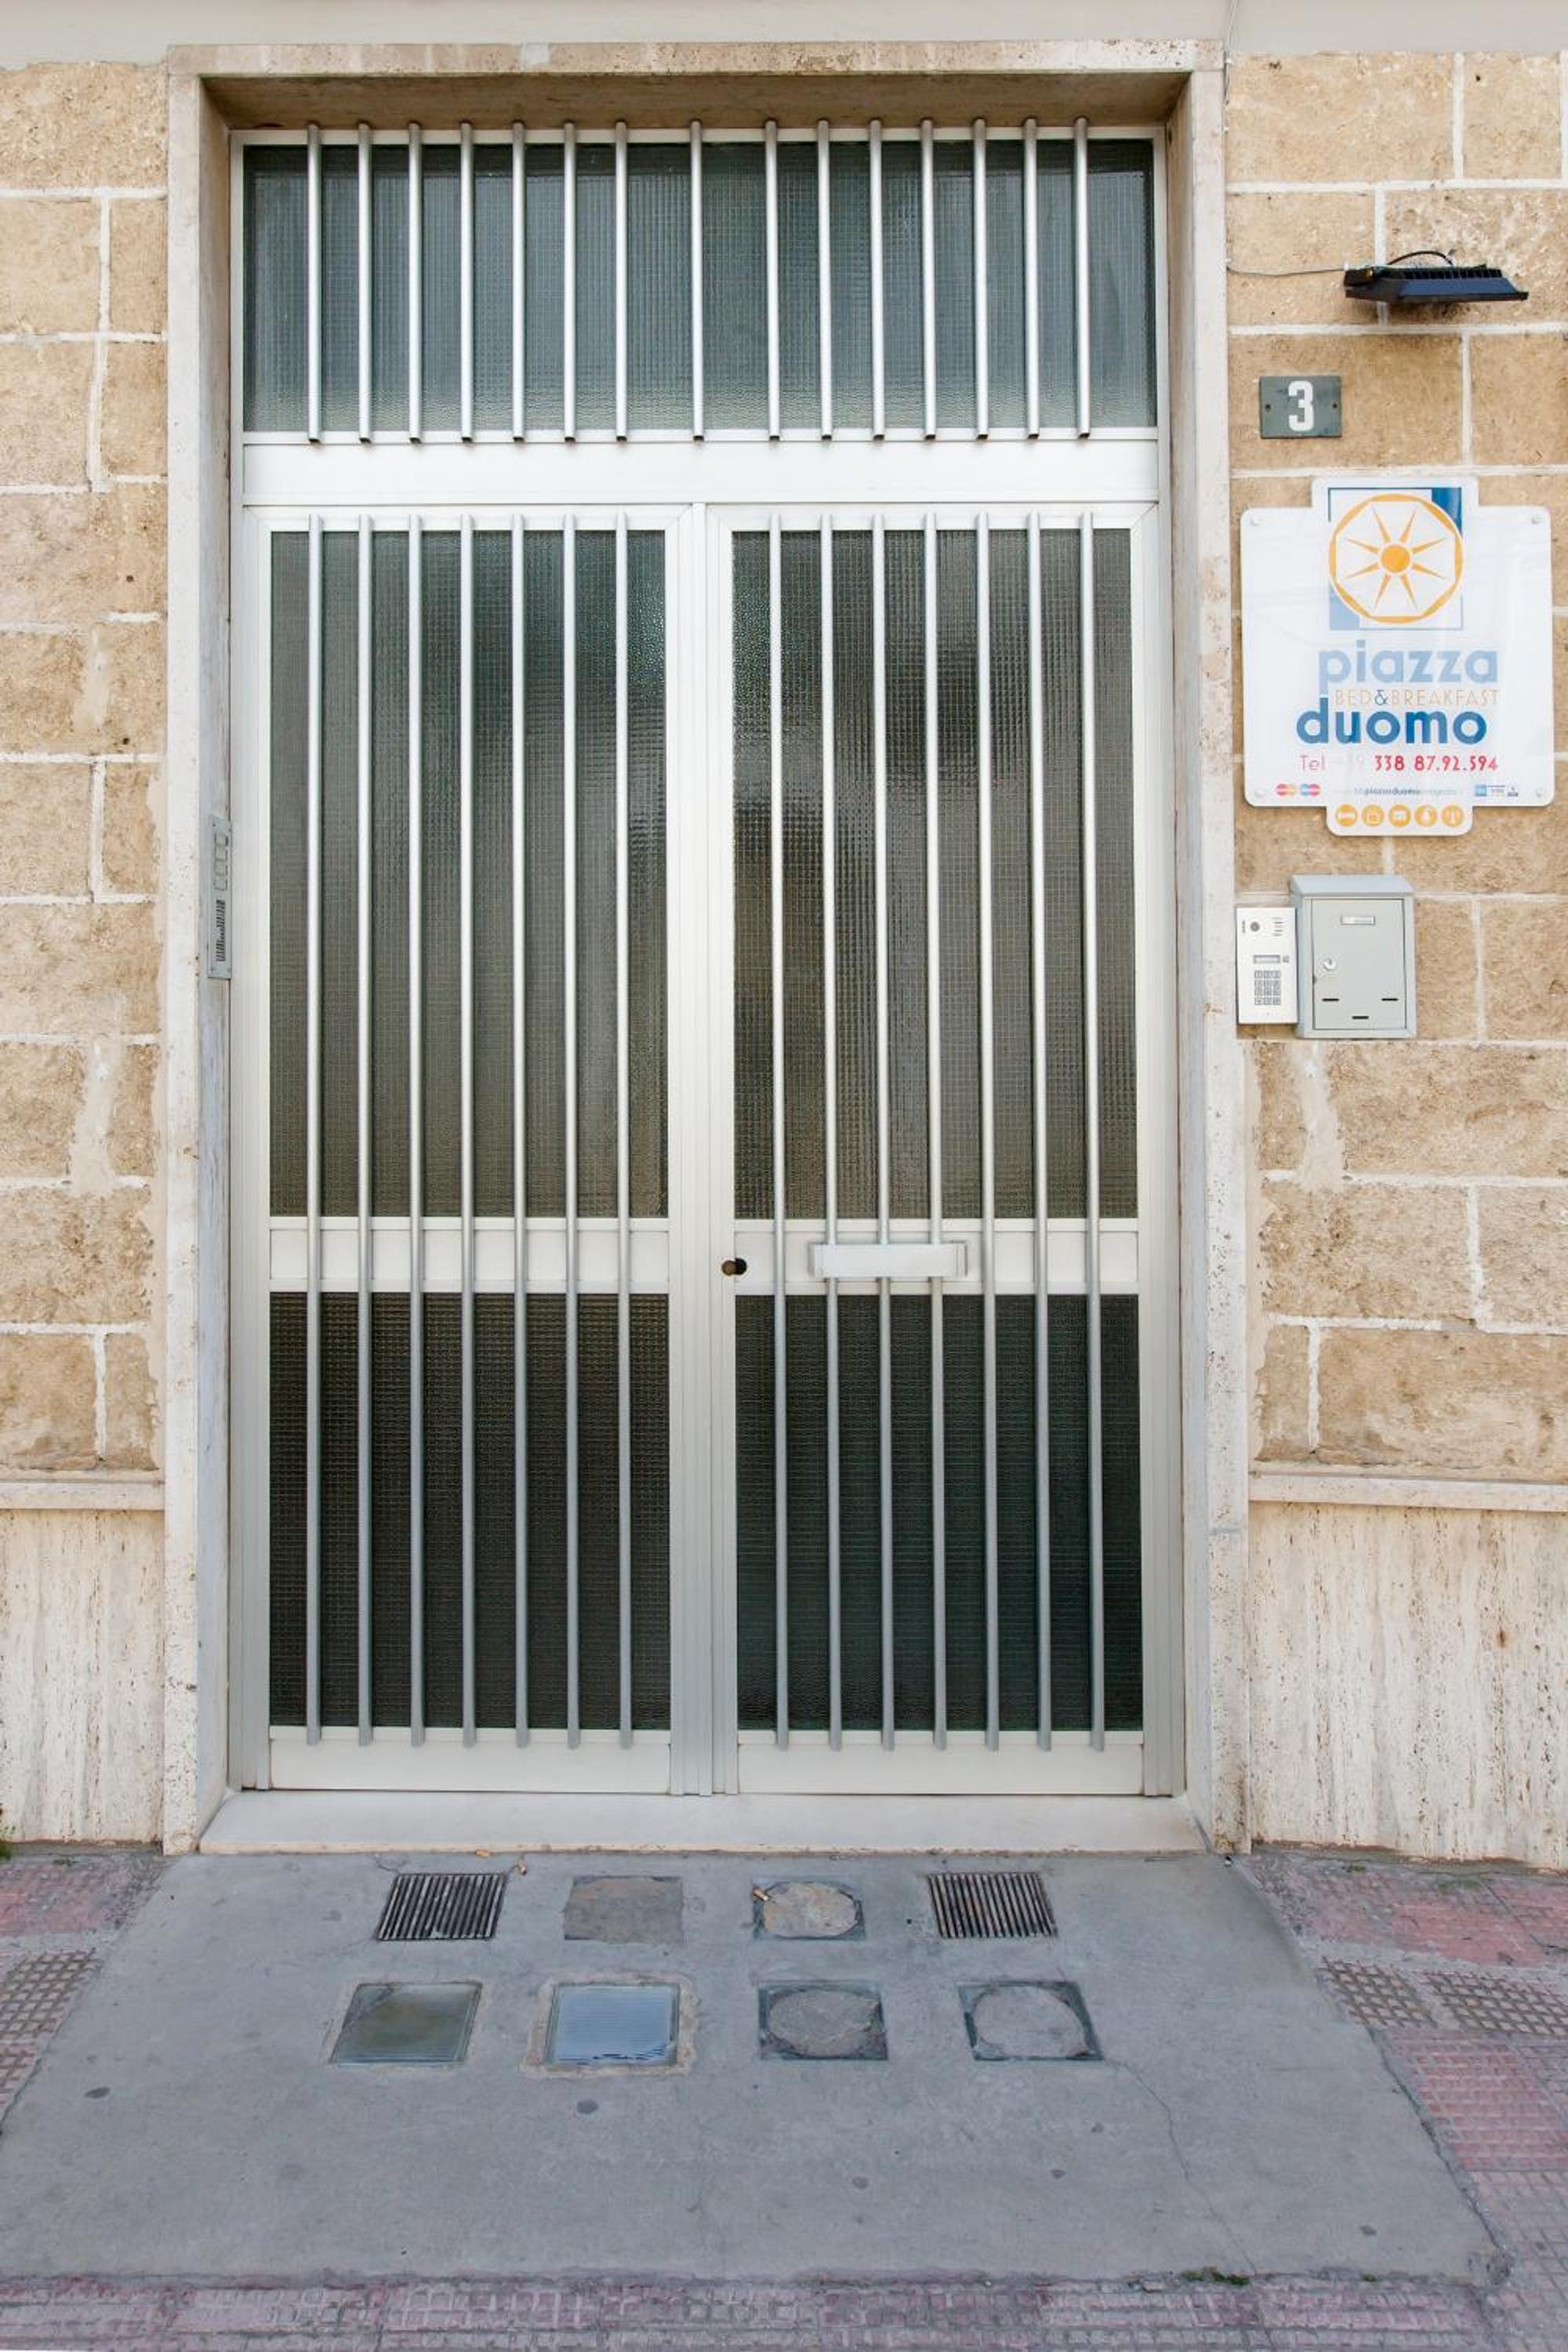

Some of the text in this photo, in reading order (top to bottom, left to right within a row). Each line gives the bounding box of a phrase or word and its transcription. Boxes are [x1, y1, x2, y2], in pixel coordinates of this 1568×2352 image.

[1288, 380, 1314, 431] 3
[1319, 640, 1498, 695] piazza
[1296, 697, 1486, 744] duomo
[1299, 755, 1327, 771] Tel
[1374, 755, 1405, 771] 338
[1414, 755, 1499, 771] 87.92.594
